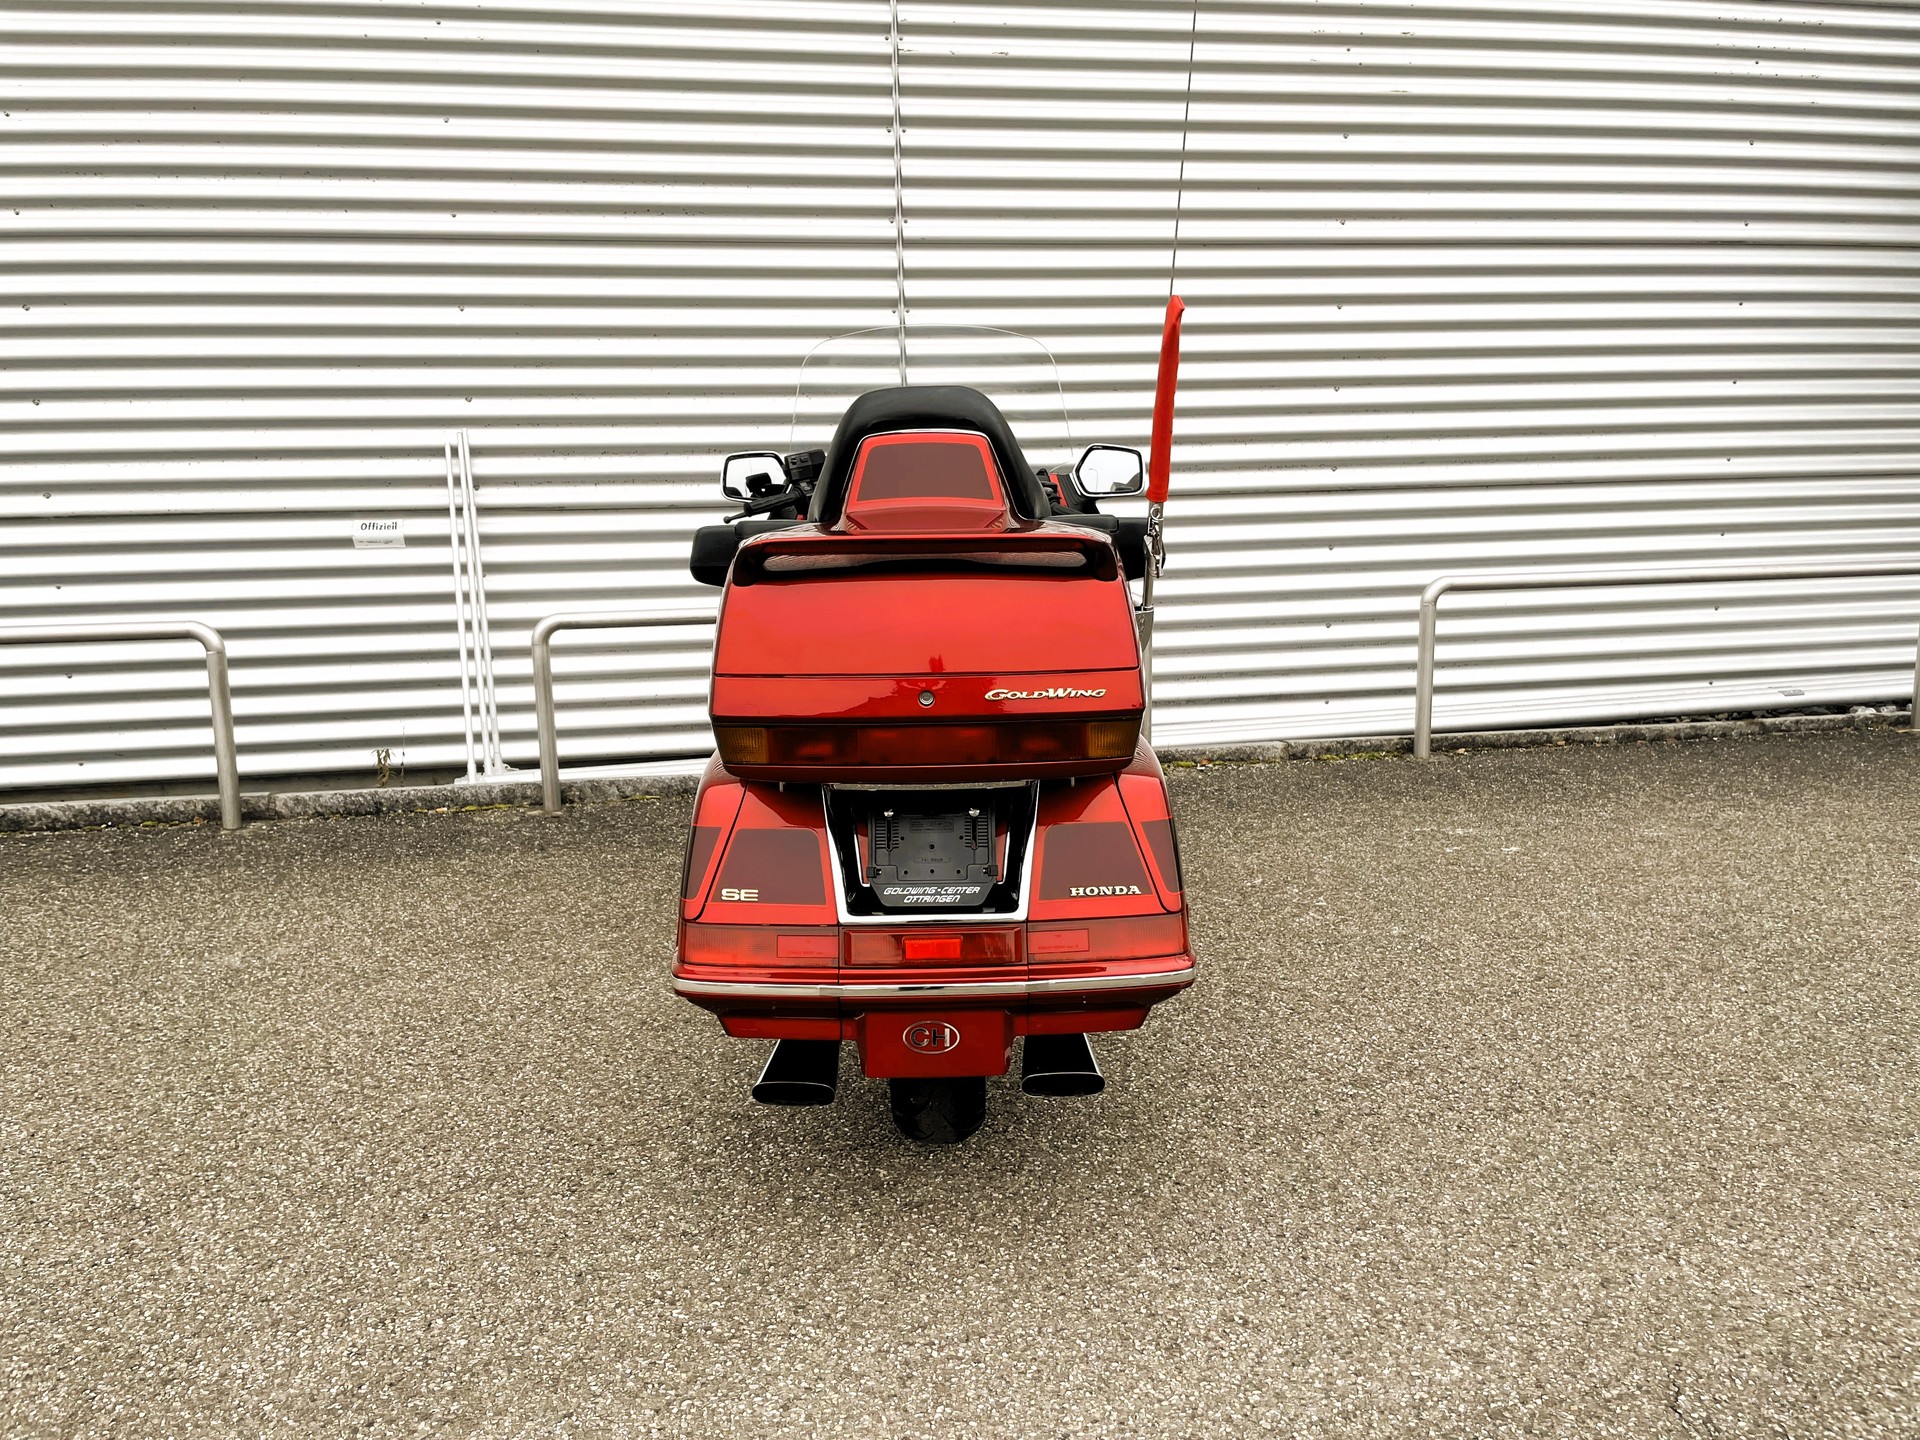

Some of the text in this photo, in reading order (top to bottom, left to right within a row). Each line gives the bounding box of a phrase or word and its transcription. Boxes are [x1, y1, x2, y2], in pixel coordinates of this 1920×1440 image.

[721, 888, 759, 902] SE
[1069, 885, 1142, 897] HONDA
[909, 1027, 951, 1047] CH
